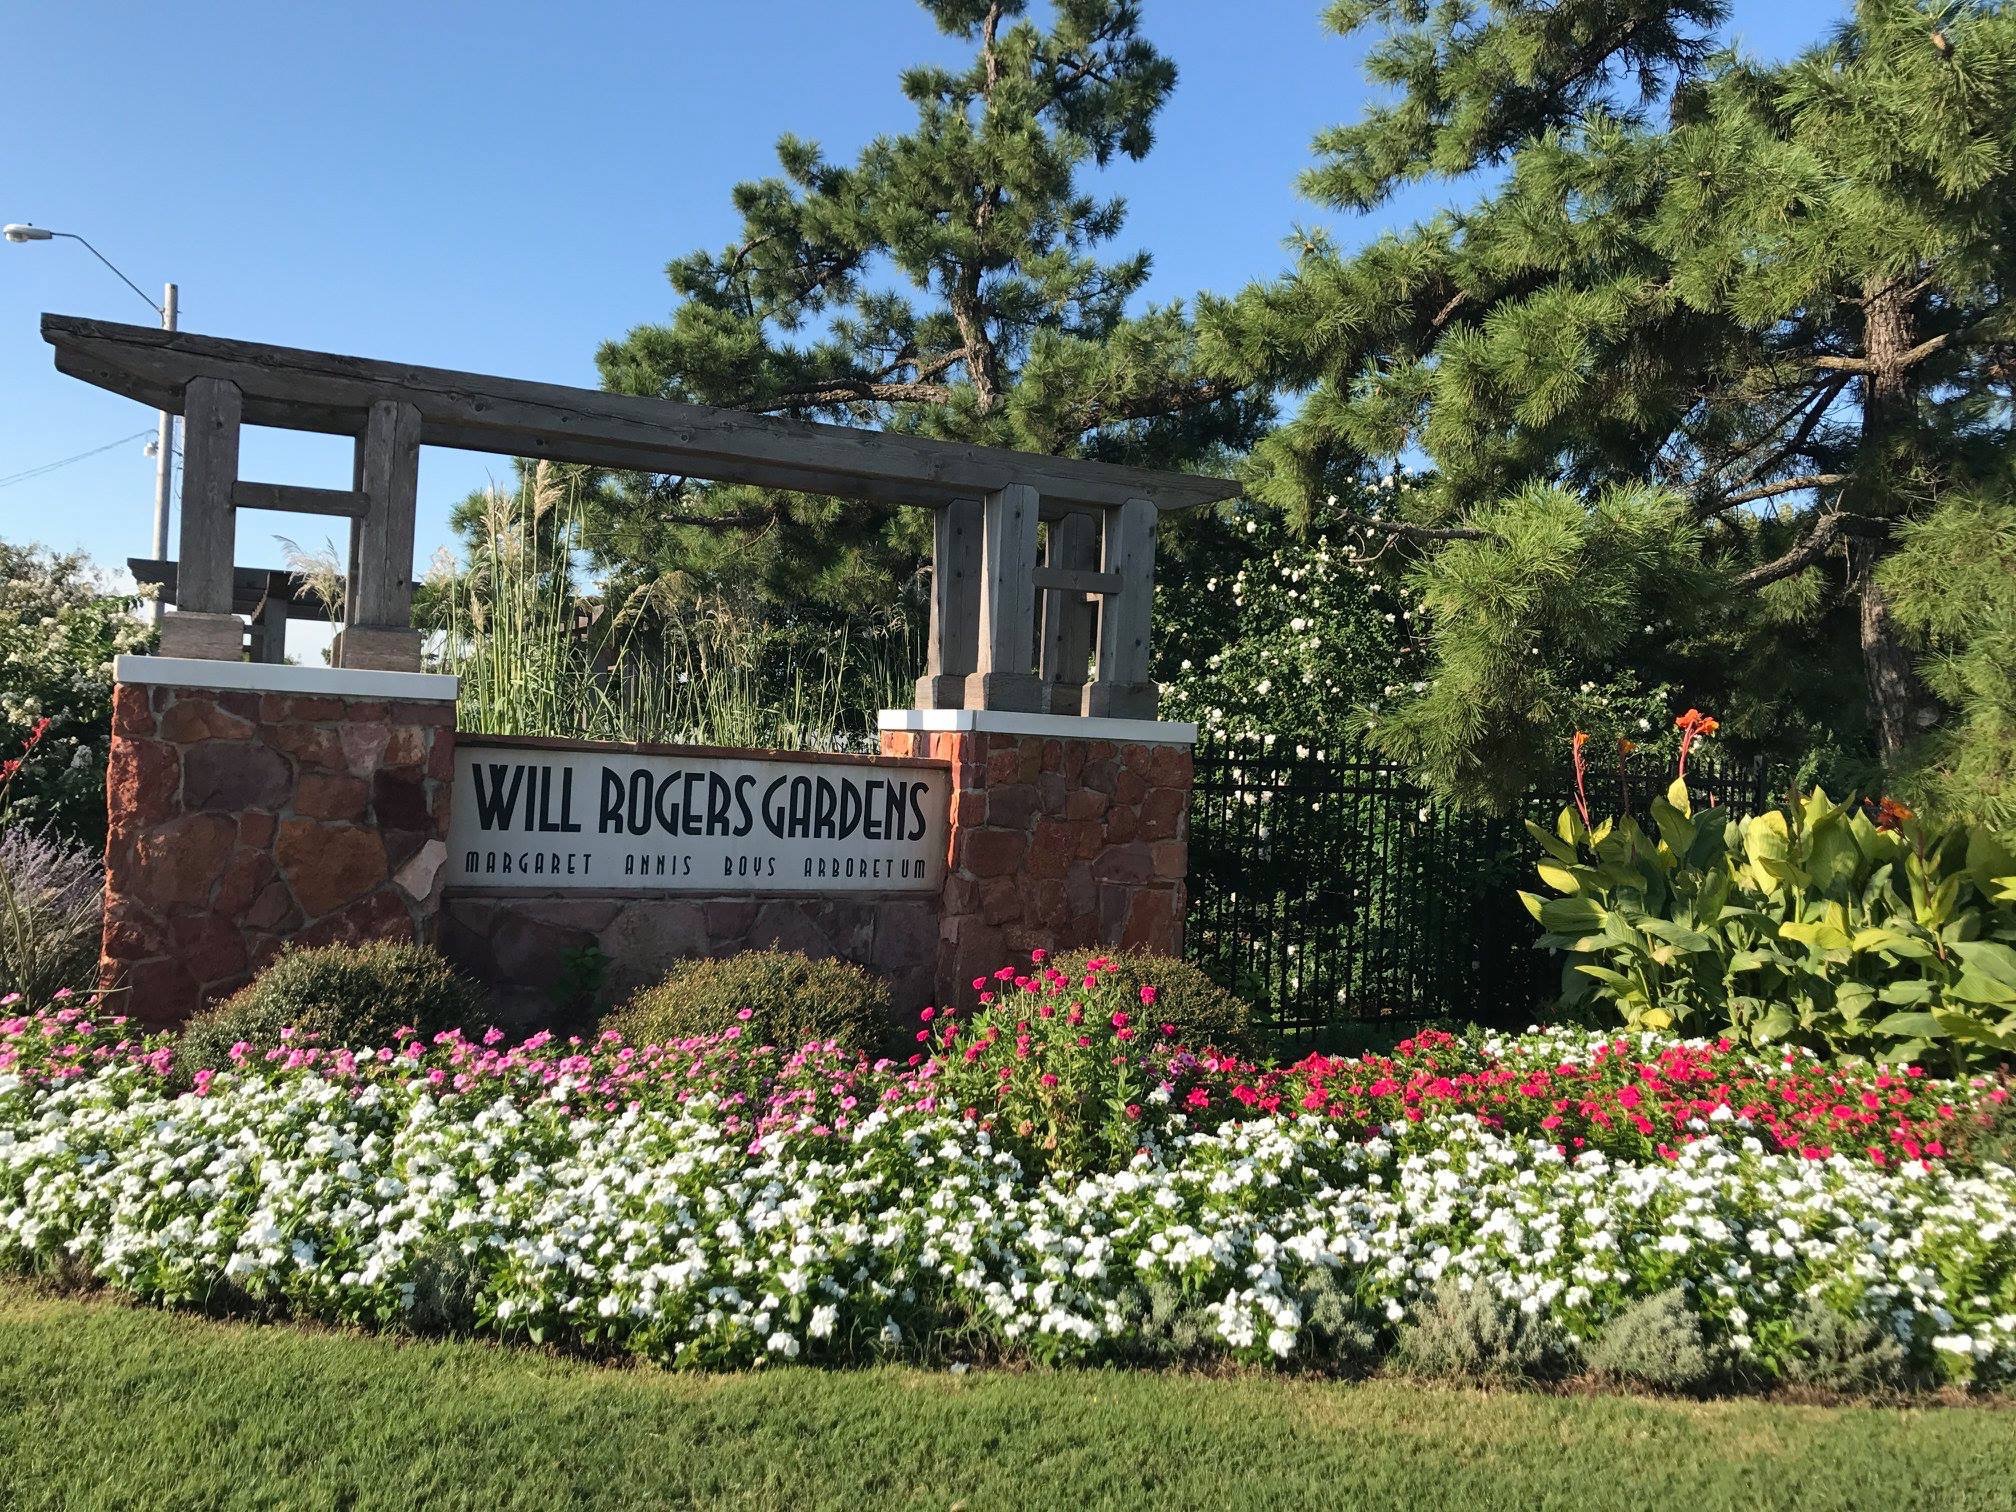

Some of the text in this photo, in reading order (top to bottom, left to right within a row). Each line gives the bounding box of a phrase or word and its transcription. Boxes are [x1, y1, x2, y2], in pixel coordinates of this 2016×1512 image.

[471, 763, 930, 842] WILL ROGERS GARDENS
[465, 851, 926, 880] MARGARET ANNIS BOYS ARBORETUM
